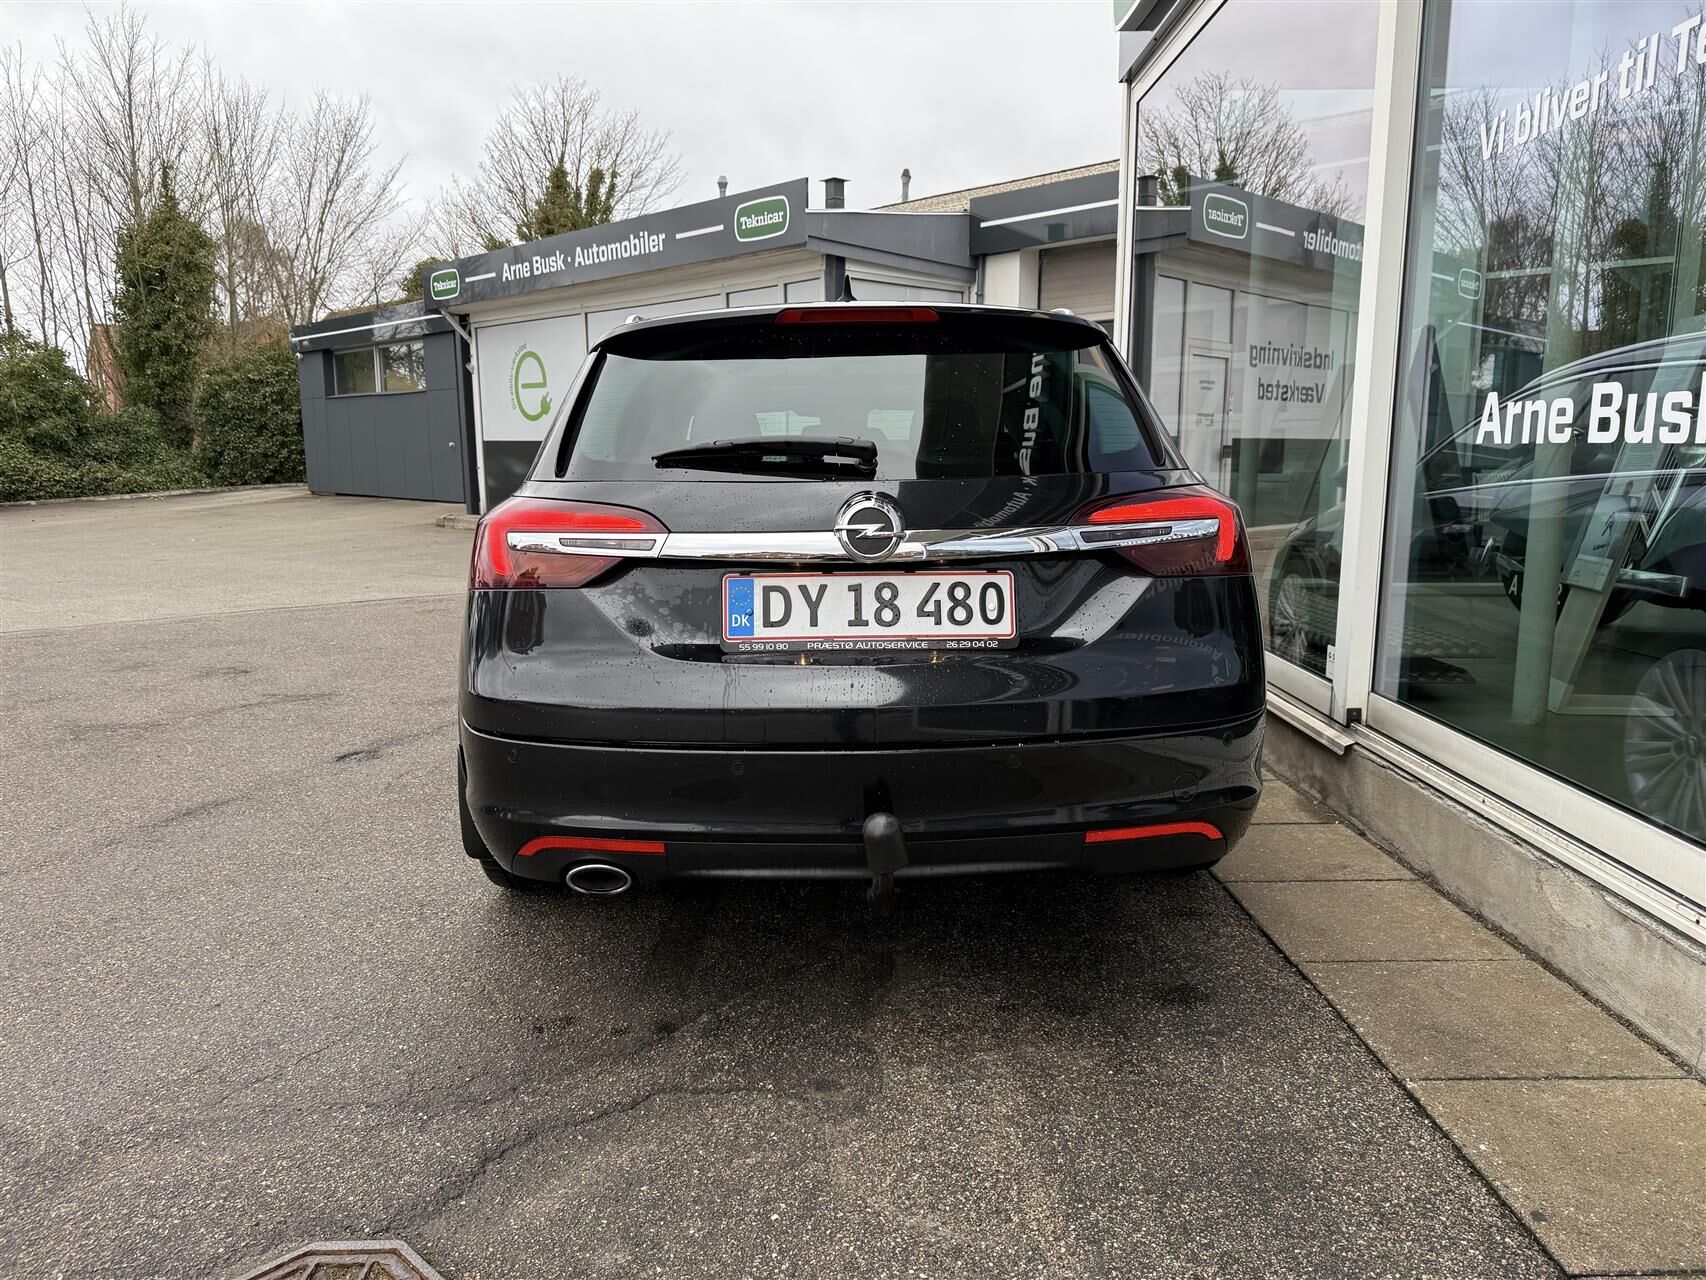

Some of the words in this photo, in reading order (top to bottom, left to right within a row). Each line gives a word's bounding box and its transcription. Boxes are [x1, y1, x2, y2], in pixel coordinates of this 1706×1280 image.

[1480, 109, 1506, 160] Vi
[1514, 68, 1609, 147] bliver
[1618, 32, 1660, 101] til
[740, 210, 784, 229] Teknicar
[502, 262, 530, 282] Arne
[533, 249, 565, 276] Busk
[574, 231, 666, 268] Automobiler
[1475, 391, 1574, 445] Arne
[731, 614, 751, 627] DK
[762, 583, 828, 628] DY
[847, 581, 900, 628] 18
[916, 581, 1005, 626] 480
[738, 643, 751, 651] 55
[775, 642, 789, 650] 80
[807, 641, 854, 650] PRÆSTØ
[855, 641, 929, 649] AUTOSERVICE
[946, 640, 958, 648] 26
